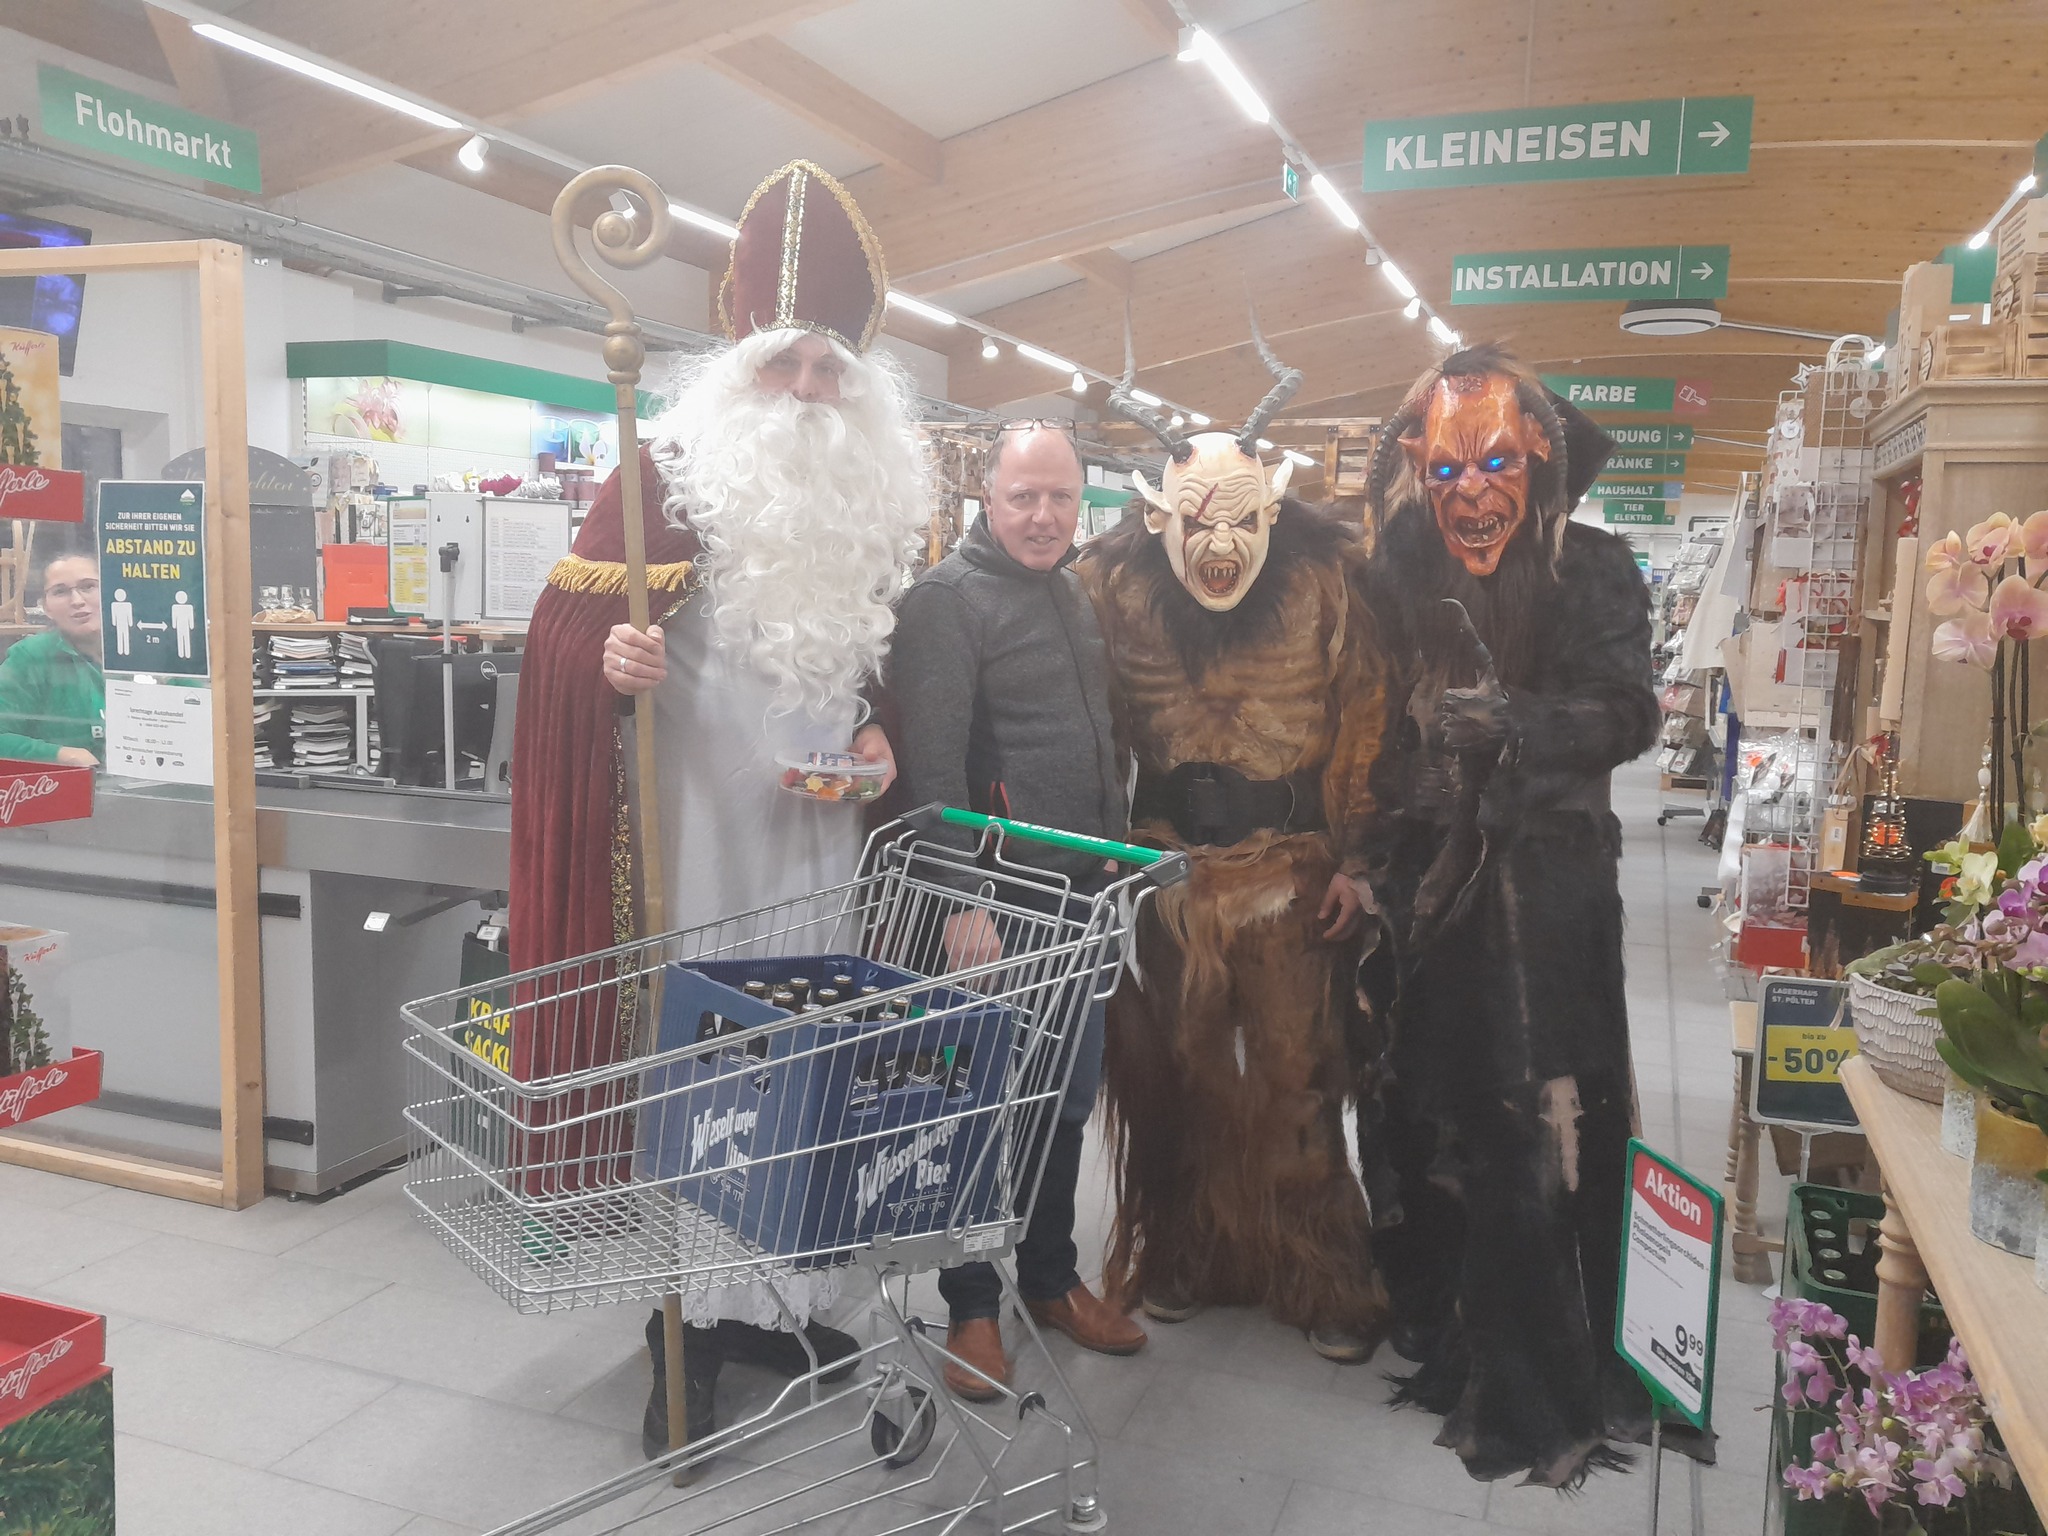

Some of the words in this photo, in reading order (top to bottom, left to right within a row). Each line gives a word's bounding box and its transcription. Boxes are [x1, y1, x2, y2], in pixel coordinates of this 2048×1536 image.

[75, 91, 233, 169] Flohmarkt
[1385, 119, 1651, 172] KLEINEISEN
[1455, 260, 1672, 291] INSTALLATION
[1568, 384, 1637, 403] FARBE
[1597, 485, 1655, 495] HAUSHALT
[1623, 503, 1644, 512] TIER
[117, 512, 131, 520] ZUR
[131, 512, 152, 520] IHRER
[152, 512, 182, 521] EIGENEN
[1614, 513, 1653, 522] ELEKTRO
[105, 522, 143, 531] SICHERHEIT
[144, 523, 168, 531] BITTEN
[169, 524, 183, 532] WIR
[184, 524, 195, 532] SIE
[106, 538, 174, 555] ABSTAND
[177, 540, 196, 556] ZU
[122, 562, 181, 580] HALTEN
[146, 635, 151, 644] 2
[1772, 987, 1819, 997] LAGERHAUS
[1644, 1167, 1702, 1226] Aktion
